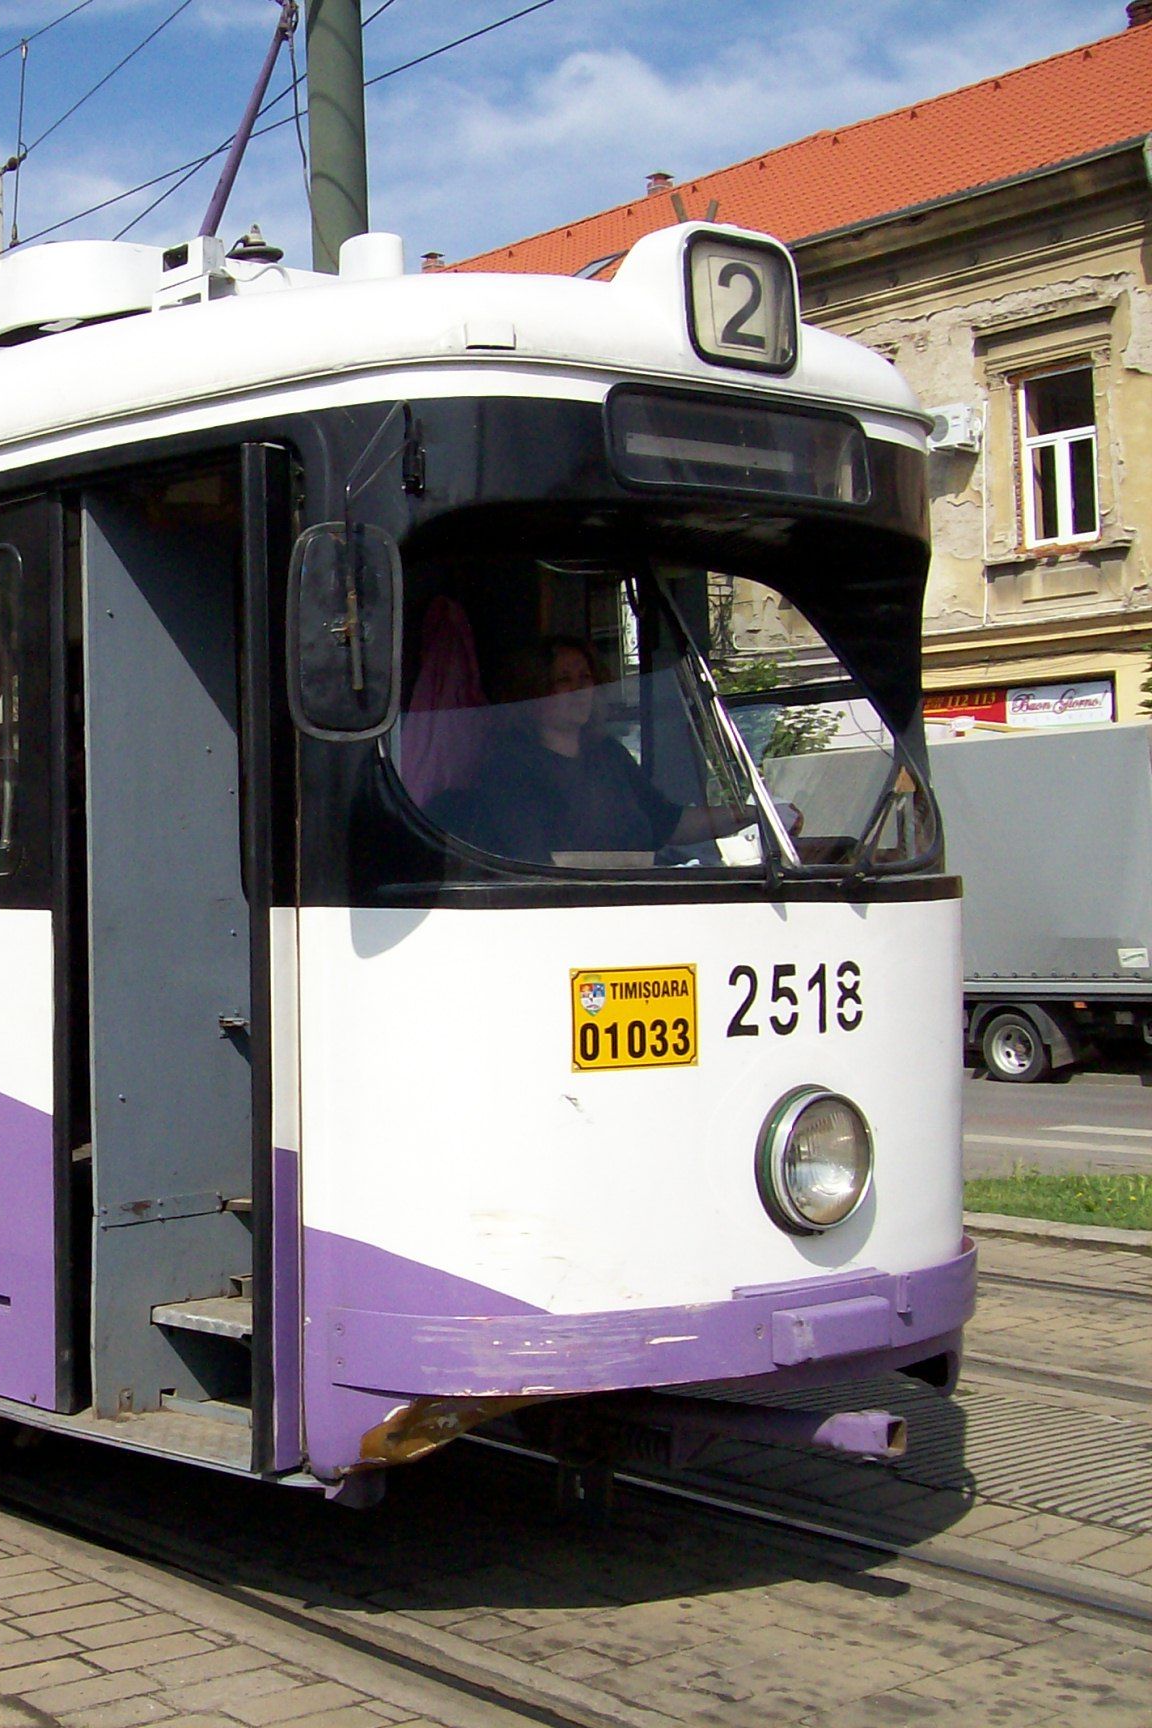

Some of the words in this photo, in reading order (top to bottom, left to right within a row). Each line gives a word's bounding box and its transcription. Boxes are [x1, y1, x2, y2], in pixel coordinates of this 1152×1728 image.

[717, 262, 766, 350] 2
[1011, 692, 1051, 713] Buon
[727, 960, 864, 1037] 2518
[579, 1018, 691, 1062] 01033
